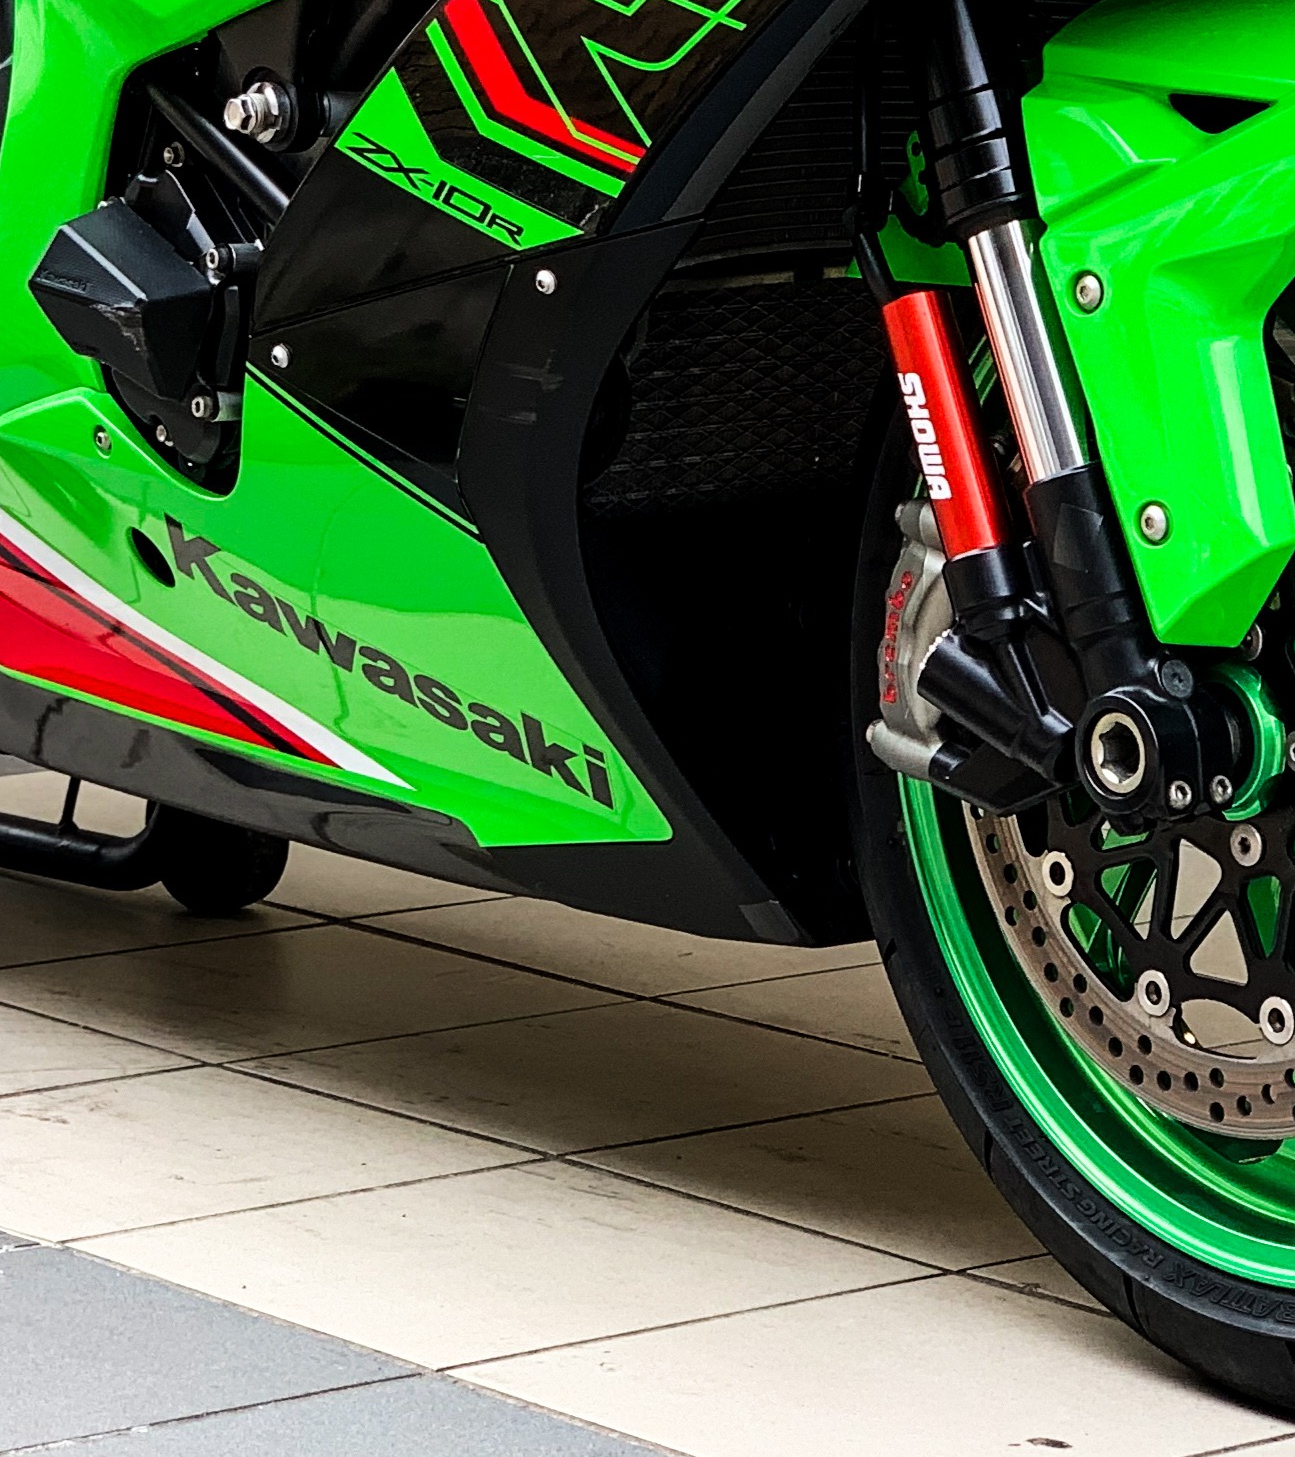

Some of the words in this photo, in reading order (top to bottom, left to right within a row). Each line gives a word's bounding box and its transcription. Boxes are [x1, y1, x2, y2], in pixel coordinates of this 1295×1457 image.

[345, 132, 525, 247] ZX-10R
[897, 372, 953, 500] SHOWA
[164, 513, 615, 811] Kawasaki
[883, 570, 914, 704] brembo
